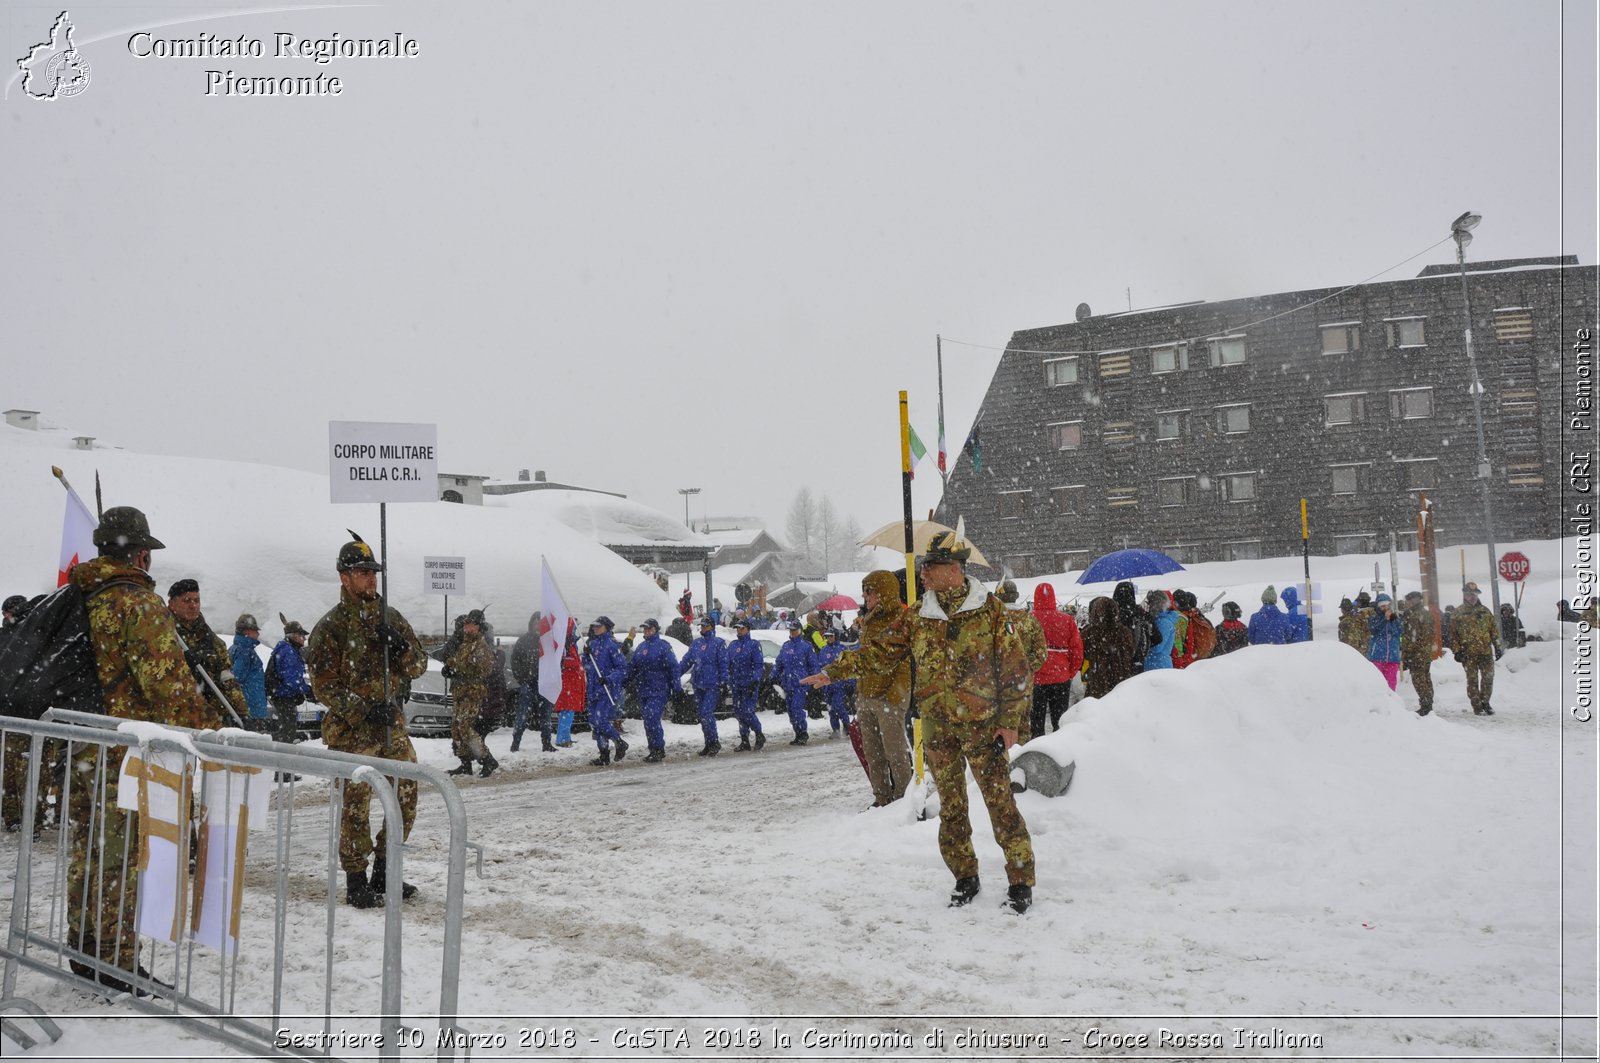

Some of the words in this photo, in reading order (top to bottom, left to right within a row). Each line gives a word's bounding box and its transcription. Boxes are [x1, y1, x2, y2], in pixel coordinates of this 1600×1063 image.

[334, 444, 376, 459] CORPO
[380, 445, 434, 460] MILITARE
[350, 466, 388, 481] DELLA
[391, 467, 421, 481] C.R.I.
[425, 561, 438, 569] CORPO
[439, 561, 464, 570] INFERMIERE
[1500, 561, 1528, 573] STOP
[432, 582, 444, 590] DELLA
